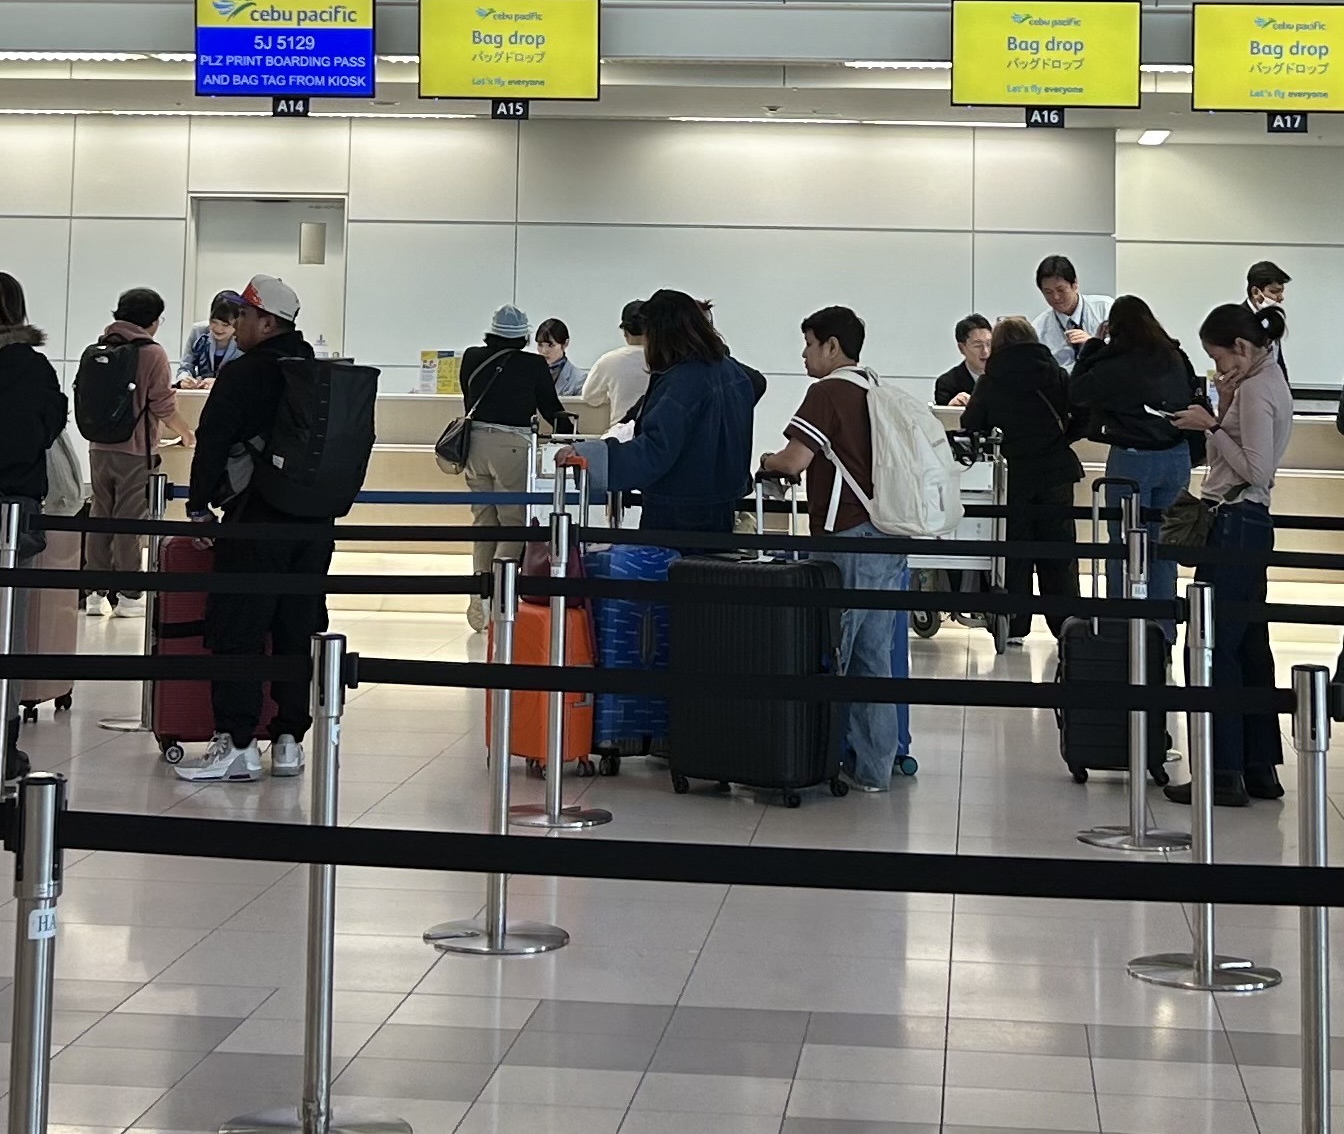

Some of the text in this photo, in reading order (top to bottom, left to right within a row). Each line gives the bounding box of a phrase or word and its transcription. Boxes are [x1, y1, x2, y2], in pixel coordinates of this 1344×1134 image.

[250, 4, 357, 26] cebu pacific
[253, 35, 315, 50] 5J 5129
[472, 30, 546, 49] Bag drop
[1007, 36, 1084, 56] Bag drop
[471, 50, 546, 64] バッグドロップ
[1249, 40, 1329, 60] Bag drop
[200, 55, 366, 67] PLZ PRINT BOARDING PASS
[1006, 57, 1085, 70] バッグドロップ
[1249, 62, 1330, 75] バッグドロップ
[203, 74, 367, 87] AND BAG TAG FROM KIOSK
[277, 99, 305, 113] A14
[496, 102, 524, 115] A15
[1030, 109, 1060, 124] A16
[1272, 114, 1302, 129] A17
